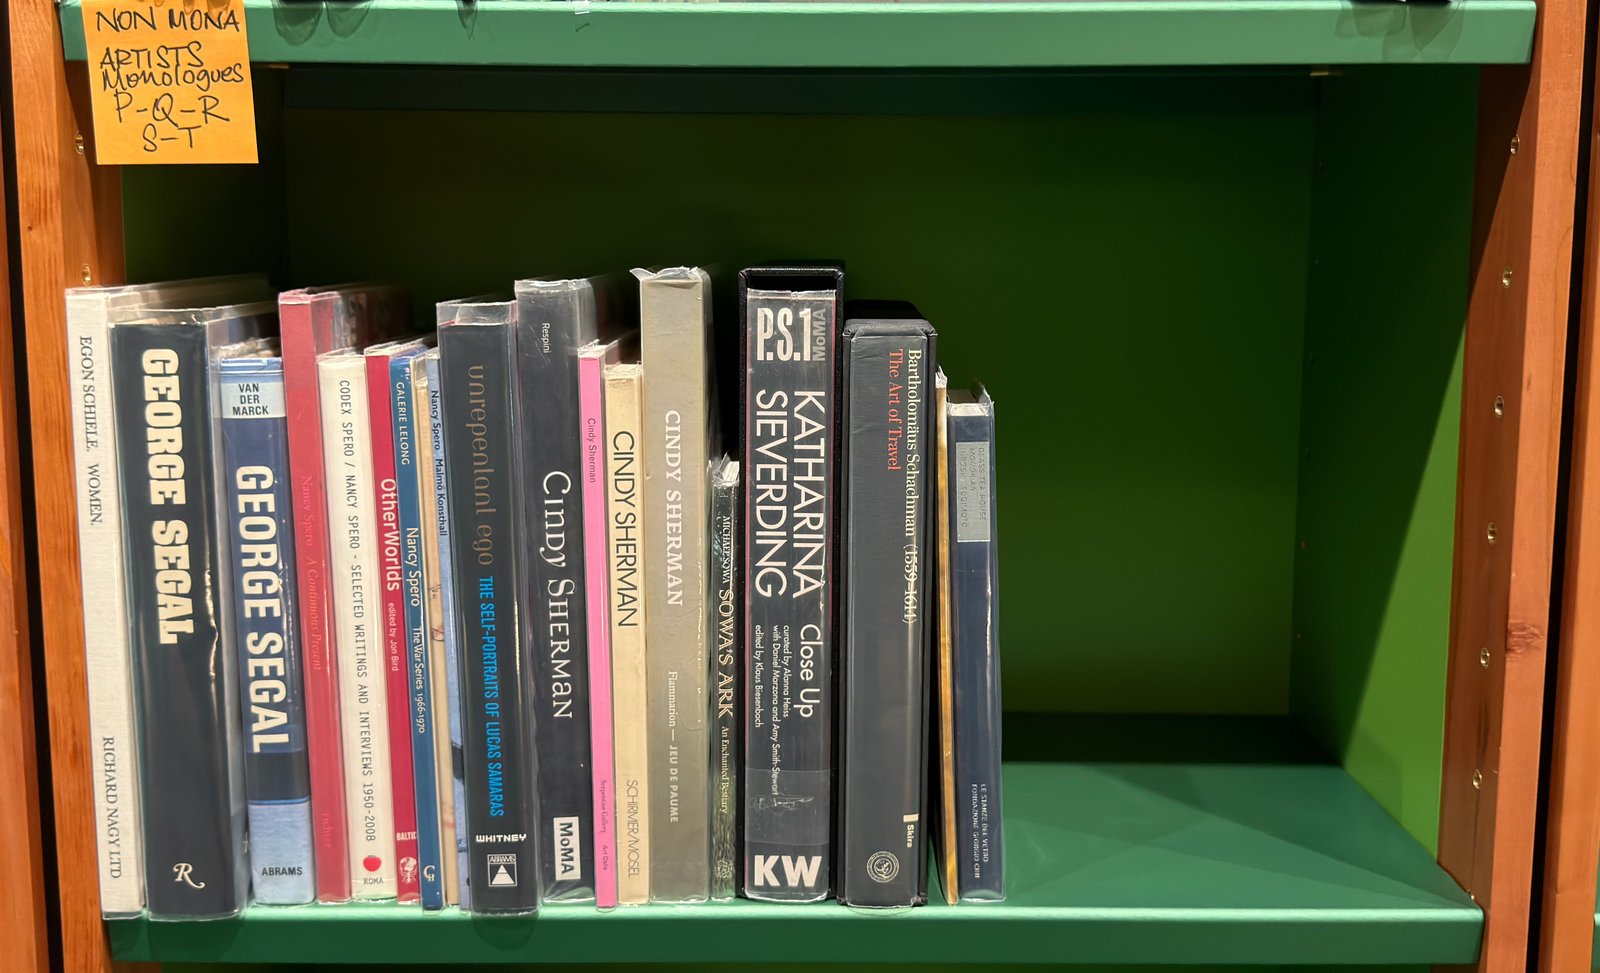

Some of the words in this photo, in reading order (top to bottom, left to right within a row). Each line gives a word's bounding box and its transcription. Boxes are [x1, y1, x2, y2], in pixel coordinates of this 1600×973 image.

[96, 6, 157, 32] NON
[168, 8, 240, 32] MONA
[100, 41, 204, 72] ARTISTS
[102, 63, 244, 92] Monologues
[542, 322, 552, 353] Respini
[757, 308, 812, 362] P.S.1
[812, 308, 826, 362] MoMA
[888, 349, 904, 378] The
[238, 383, 260, 393] VAN
[240, 395, 260, 404] DER
[340, 380, 352, 415] CODEX
[396, 382, 407, 424] GALERIE
[430, 390, 439, 420] Nancy
[888, 381, 903, 406] Art
[907, 349, 922, 450] Bartholomäus
[142, 349, 186, 504] GEORGE
[232, 406, 269, 416] MARCK
[888, 408, 902, 424] of
[80, 336, 94, 382] EGON
[87, 463, 102, 526] WOMEN.
[342, 422, 354, 457] SPERO
[399, 427, 410, 465] LELONG
[432, 422, 442, 450] Spero
[586, 418, 596, 442] Cindy
[665, 410, 681, 482] CINDY
[588, 444, 597, 482] Sherman
[888, 426, 902, 471] Travel
[435, 458, 446, 490] Malmö
[614, 430, 636, 508] CINDY
[302, 476, 313, 511] Nancy
[346, 475, 358, 508] NANCY
[755, 389, 788, 598] SIEVERDING
[793, 391, 826, 598] KATHARINA
[906, 454, 921, 537] Schachman
[303, 514, 315, 546] Spero
[348, 516, 360, 548] SPERO
[437, 494, 448, 536] Konsthall
[236, 466, 282, 618] GEORGE
[381, 478, 402, 591] OtherWorlds
[406, 528, 418, 567] Nancy
[472, 524, 494, 565] ego
[666, 490, 682, 606] SHERMAN
[152, 520, 194, 644] SEGAL
[615, 512, 638, 626] SHERMAN
[308, 568, 320, 631] Continuous
[352, 564, 364, 618] SELECTED
[409, 571, 422, 606] Spero
[480, 576, 494, 599] THE
[390, 628, 398, 636] by
[413, 628, 422, 644] The
[755, 624, 764, 649] edited
[784, 624, 792, 654] curated
[312, 634, 322, 670] Present
[355, 624, 368, 678] WRITINGS
[414, 644, 424, 662] War
[480, 603, 498, 698] SELF-PORTRAITS
[754, 650, 764, 660] by
[772, 643, 781, 668] Daniel
[782, 656, 792, 666] by
[800, 624, 824, 680] Close
[414, 663, 425, 690] Series
[755, 662, 764, 683] Klaus
[772, 670, 780, 704] Marzona
[784, 668, 792, 696] Alanna
[246, 632, 289, 752] SEGAL
[358, 684, 368, 704] AND
[486, 702, 499, 717] OF
[668, 672, 678, 727] Flammarion
[718, 672, 734, 718] ARK
[755, 685, 764, 728] Biesenbach
[783, 698, 792, 718] Heiss
[794, 688, 820, 718] Up
[415, 694, 425, 734] 1966-1970
[772, 706, 781, 721] and
[360, 712, 372, 776] INTERVIEWS
[486, 722, 502, 758] LUCAS
[722, 726, 730, 737] An
[770, 724, 780, 742] Amy
[102, 736, 118, 804] RICHARD
[670, 746, 678, 764] JEU
[721, 738, 730, 780] Enchanted
[772, 743, 781, 795] Smith-Stewart
[488, 762, 504, 816] SAMARAS
[670, 769, 678, 782] DE
[981, 784, 986, 792] LE
[363, 783, 376, 842] 1950-2008
[670, 785, 678, 822] PAUME
[720, 782, 730, 814] Bestiary
[107, 808, 120, 848] NAGY
[476, 834, 527, 842] WHITNEY
[627, 780, 640, 878] SCHIRMER/MOSEL
[906, 824, 915, 848] Skira
[110, 850, 122, 879] LTD
[560, 822, 574, 874] MoMA
[262, 866, 302, 876] ABRAMS
[754, 855, 822, 887] KW
